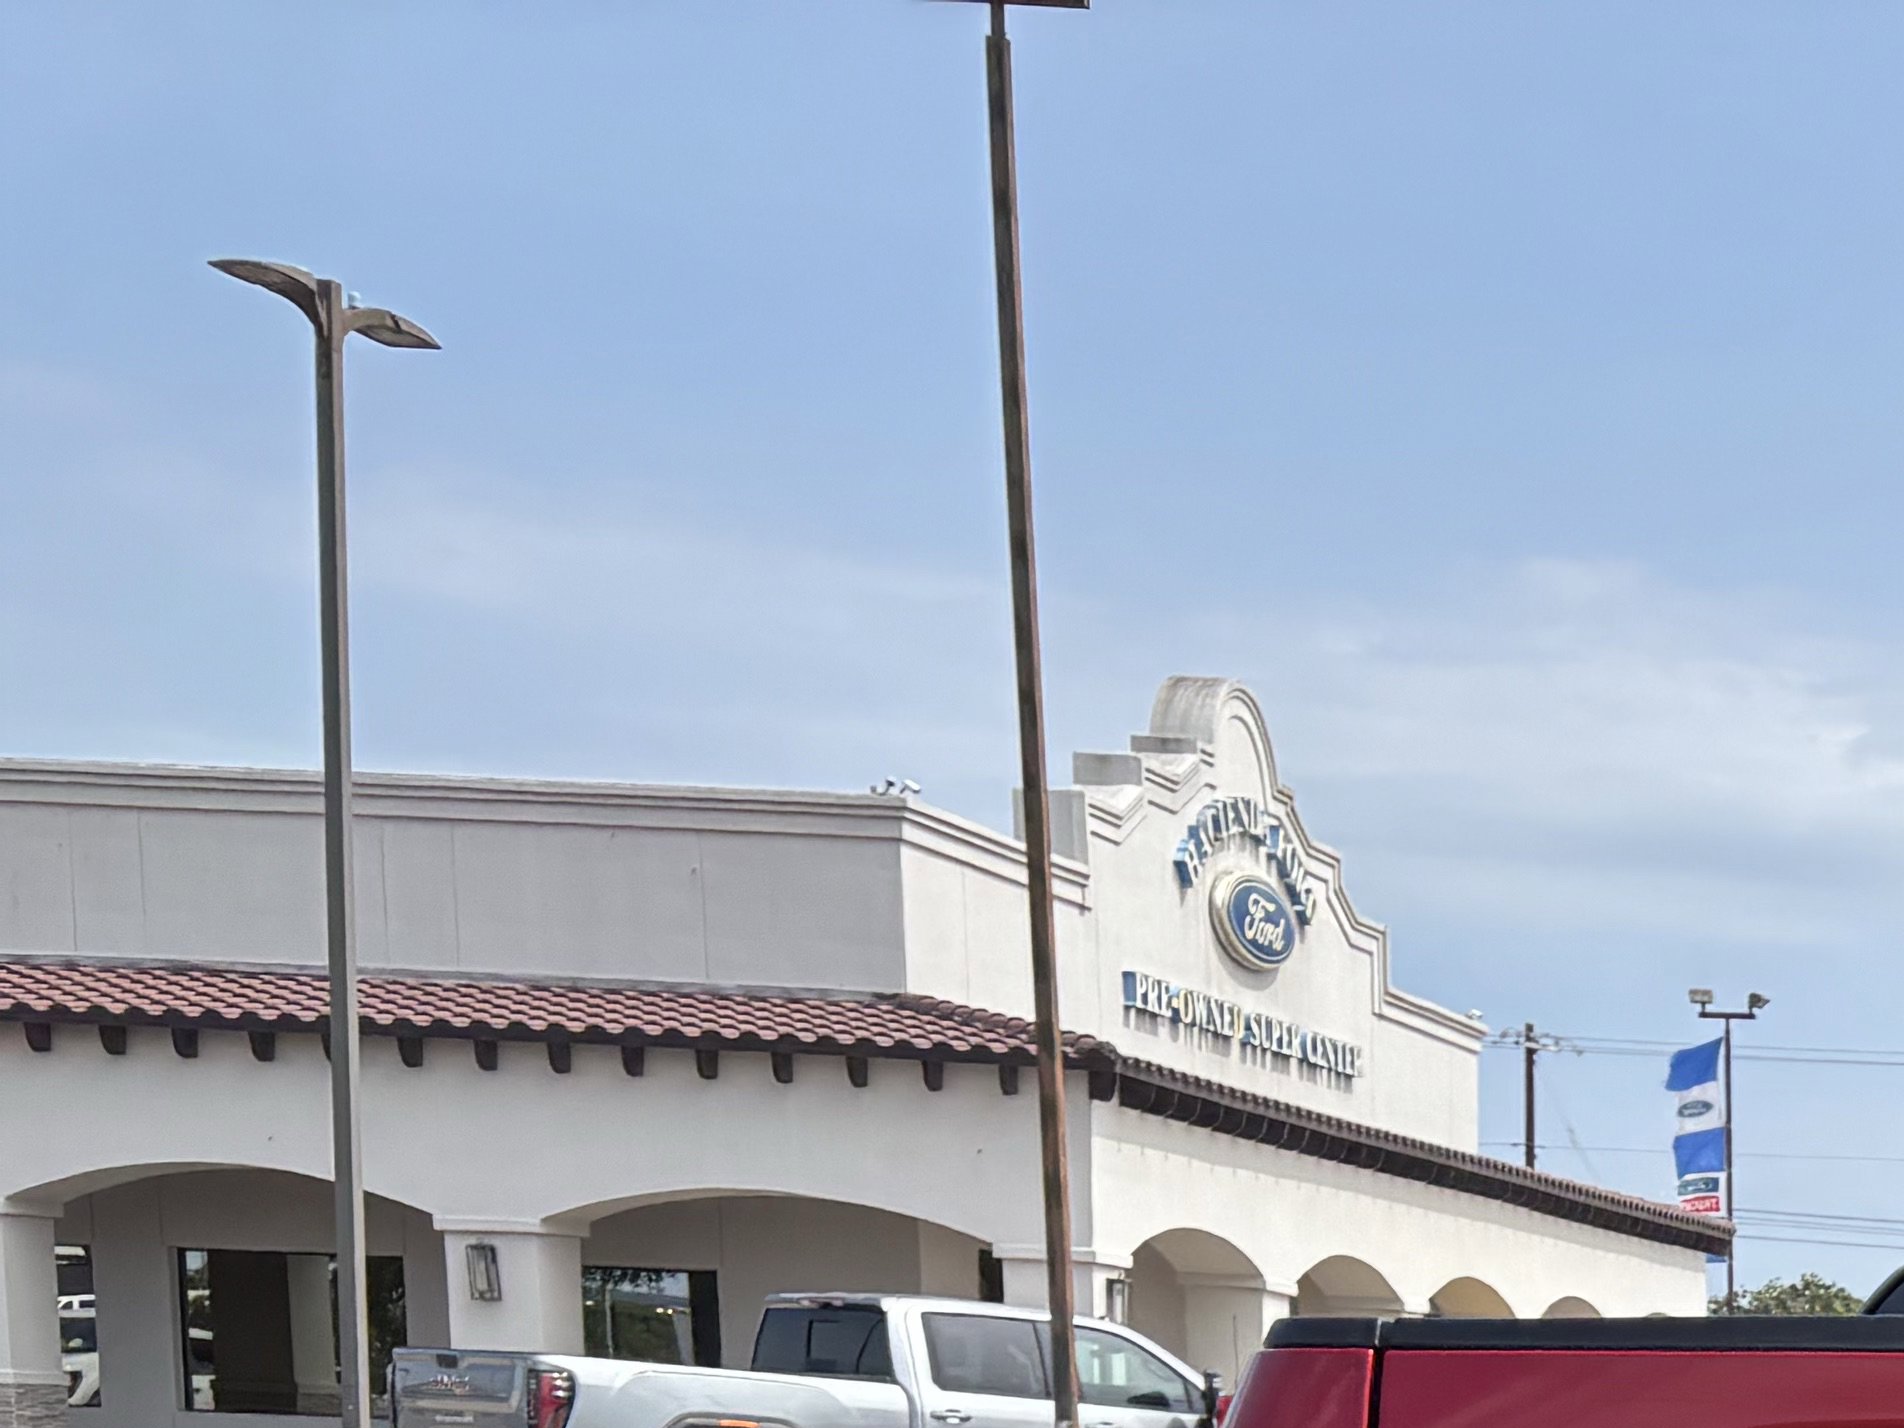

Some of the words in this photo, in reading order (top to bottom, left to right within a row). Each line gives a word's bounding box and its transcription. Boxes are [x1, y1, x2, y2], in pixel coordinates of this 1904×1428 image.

[1243, 892, 1286, 952] Ford
[1132, 971, 1245, 1041] PRE-OWNED
[1249, 1012, 1303, 1060] SUPER
[1305, 1031, 1365, 1078] CENTER
